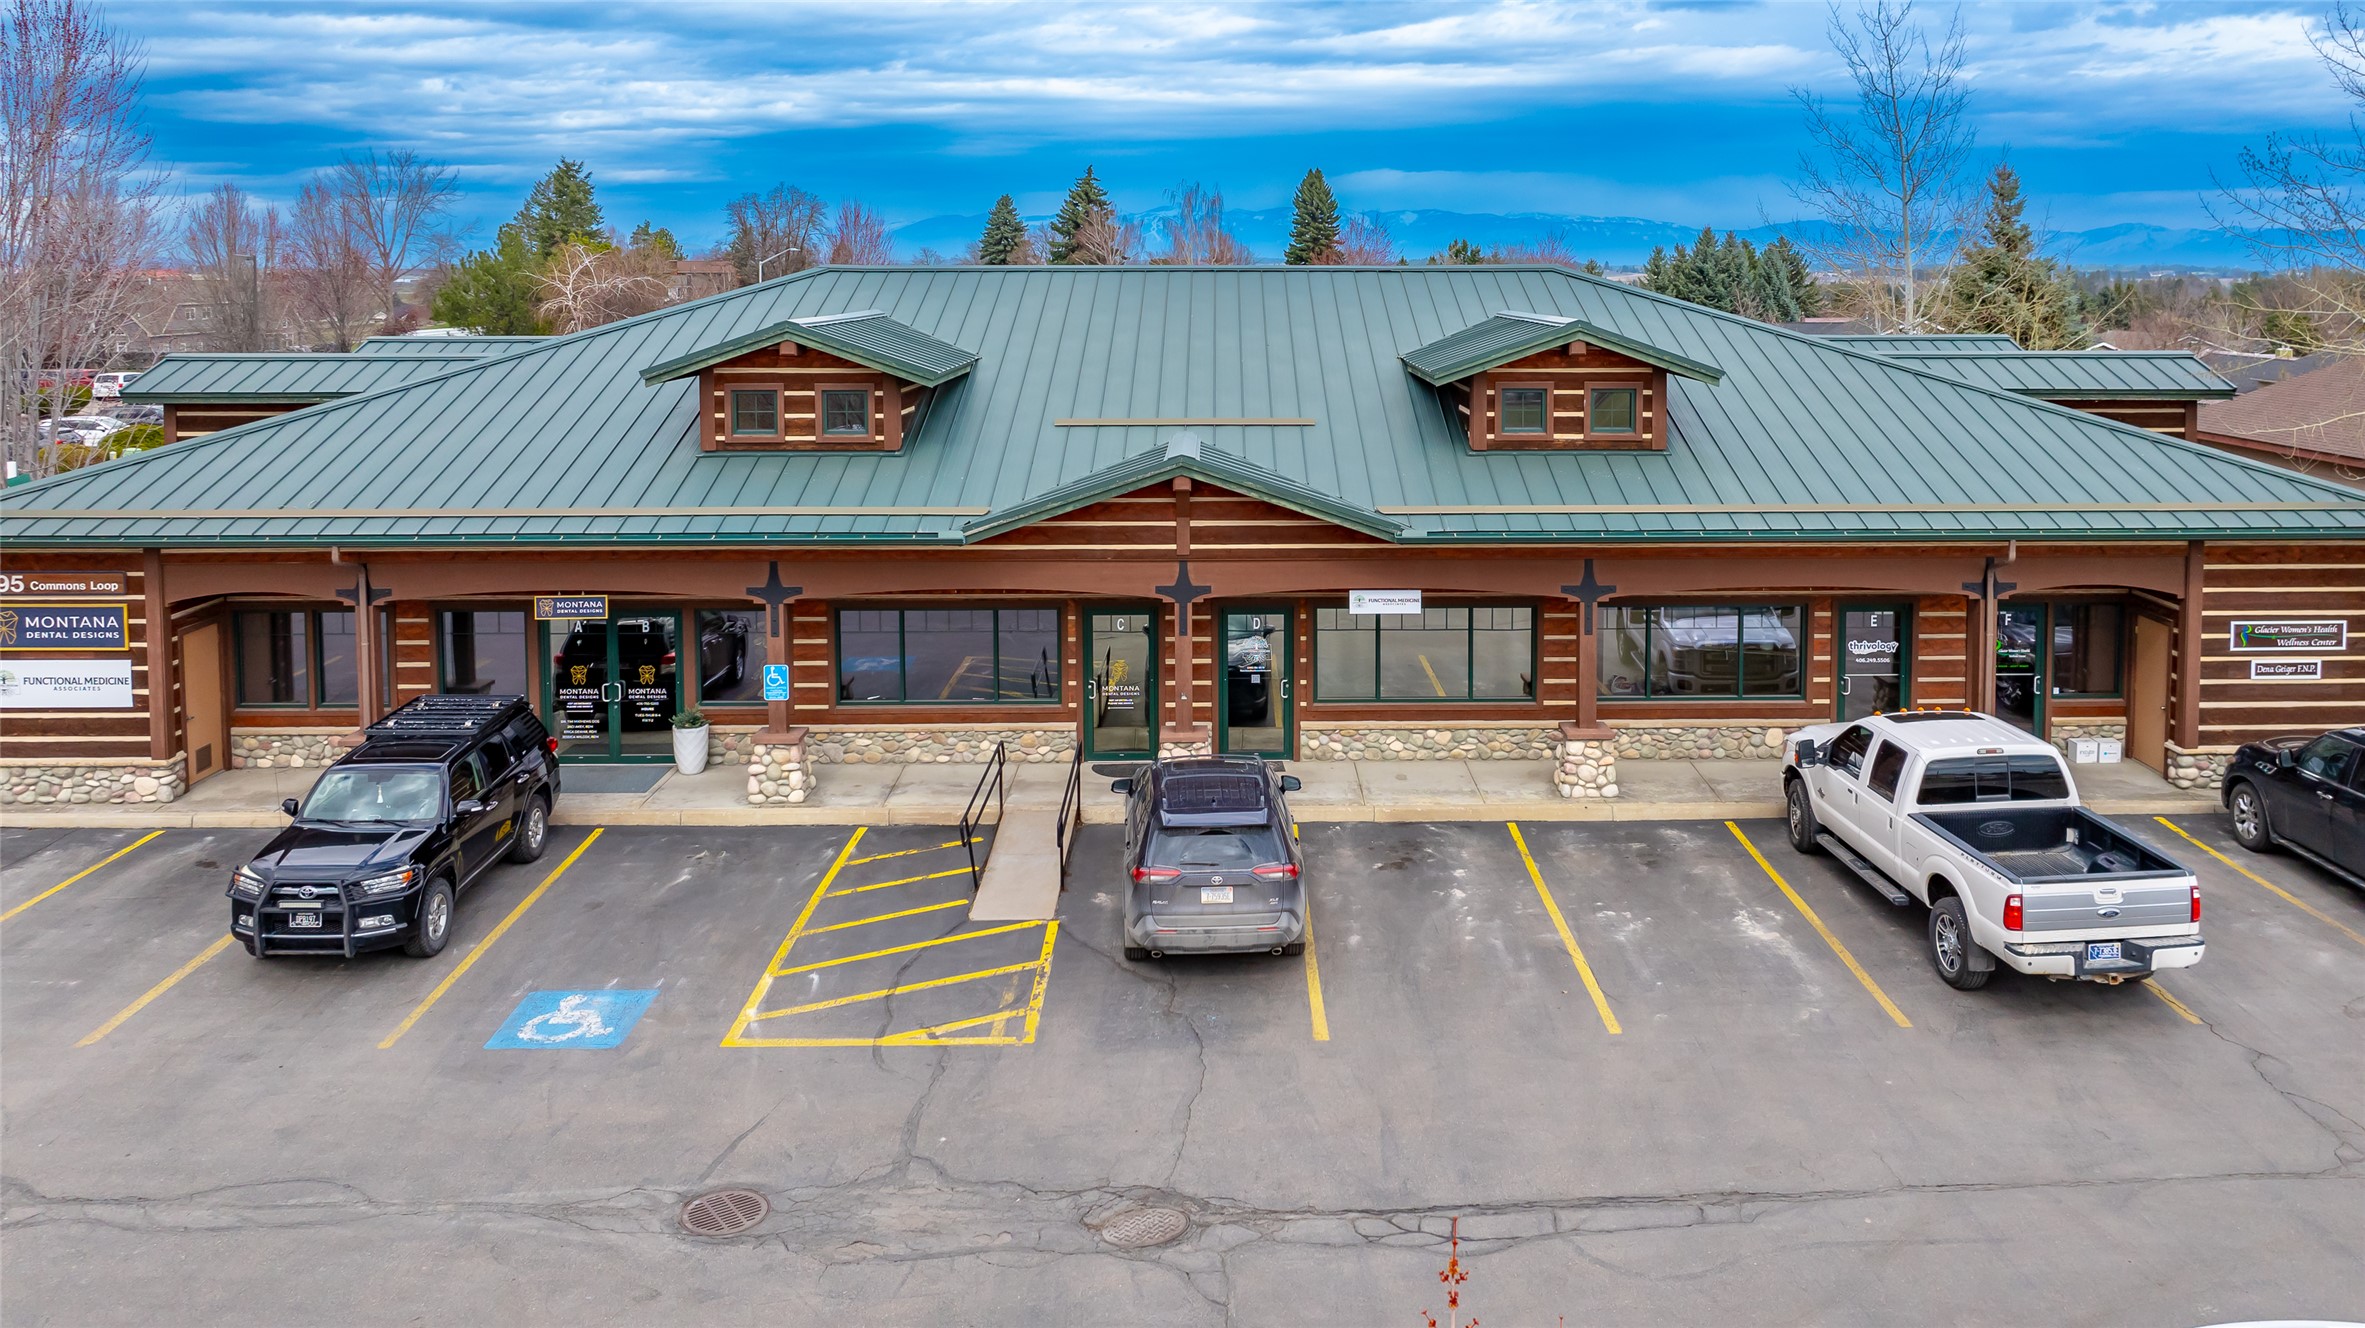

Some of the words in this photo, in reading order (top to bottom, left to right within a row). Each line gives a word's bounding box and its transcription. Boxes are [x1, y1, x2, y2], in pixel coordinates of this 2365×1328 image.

[0, 575, 25, 592] 95
[30, 581, 86, 591] Commons
[90, 581, 119, 592] Loop
[25, 616, 119, 628] MONTANA
[1117, 618, 1125, 631] C
[1253, 617, 1261, 630] D
[1871, 614, 1878, 627] E
[2004, 613, 2012, 626] F
[574, 620, 583, 633] A
[642, 621, 650, 632] B
[2254, 625, 2279, 634] Glacier
[2281, 625, 2312, 633] Women's
[2313, 624, 2338, 633] Health
[26, 631, 68, 639] DENTAL
[73, 631, 120, 639] DESIGNS
[1849, 640, 1898, 653] thrivology
[2277, 638, 2309, 646] Wellness
[2311, 638, 2337, 646] Center
[2257, 665, 2274, 673] Dena
[2275, 665, 2296, 675] Geiger
[23, 677, 82, 685] FUNCTIONAL
[84, 677, 130, 685] MEDICINE
